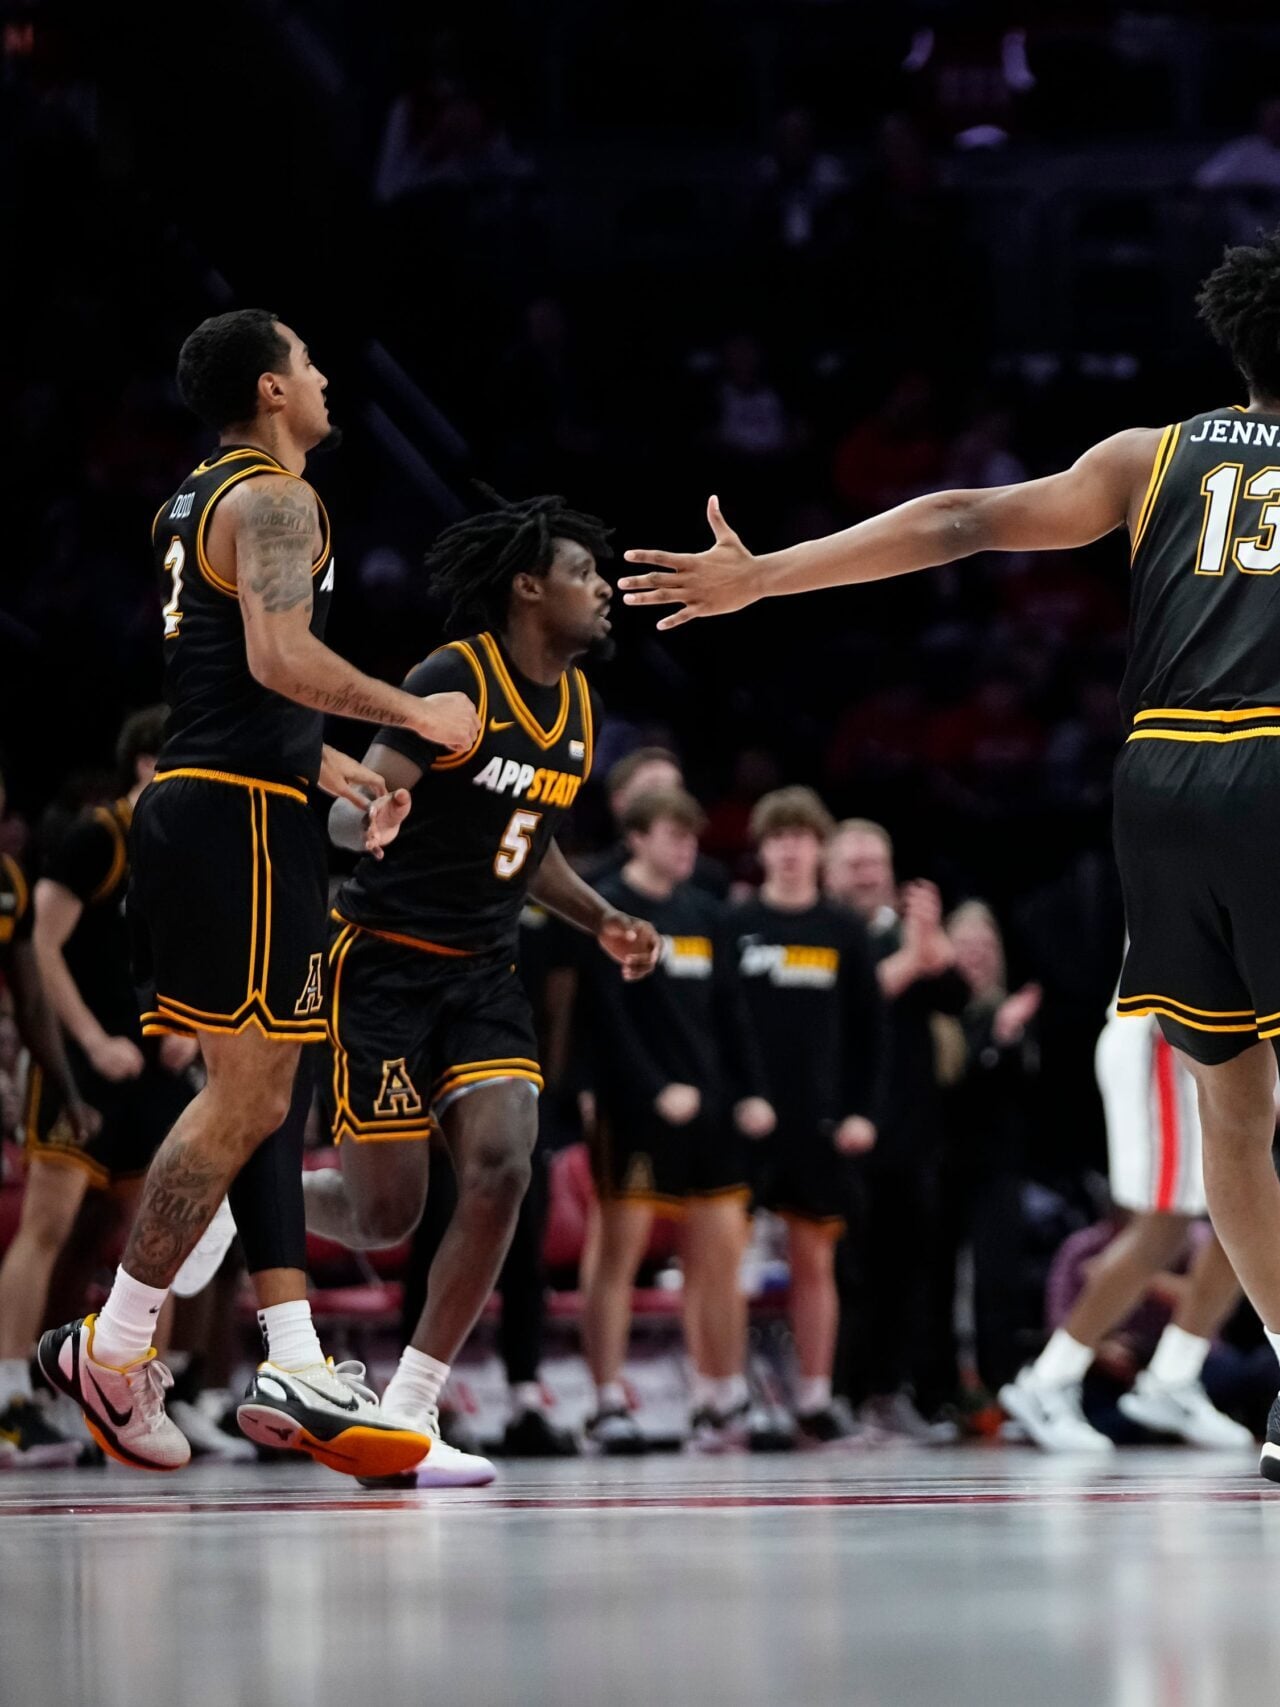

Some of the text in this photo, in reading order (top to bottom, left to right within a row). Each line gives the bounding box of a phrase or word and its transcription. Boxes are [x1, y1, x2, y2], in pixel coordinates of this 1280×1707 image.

[493, 808, 543, 881] 5
[294, 953, 323, 1016] A
[373, 1057, 422, 1118] A
